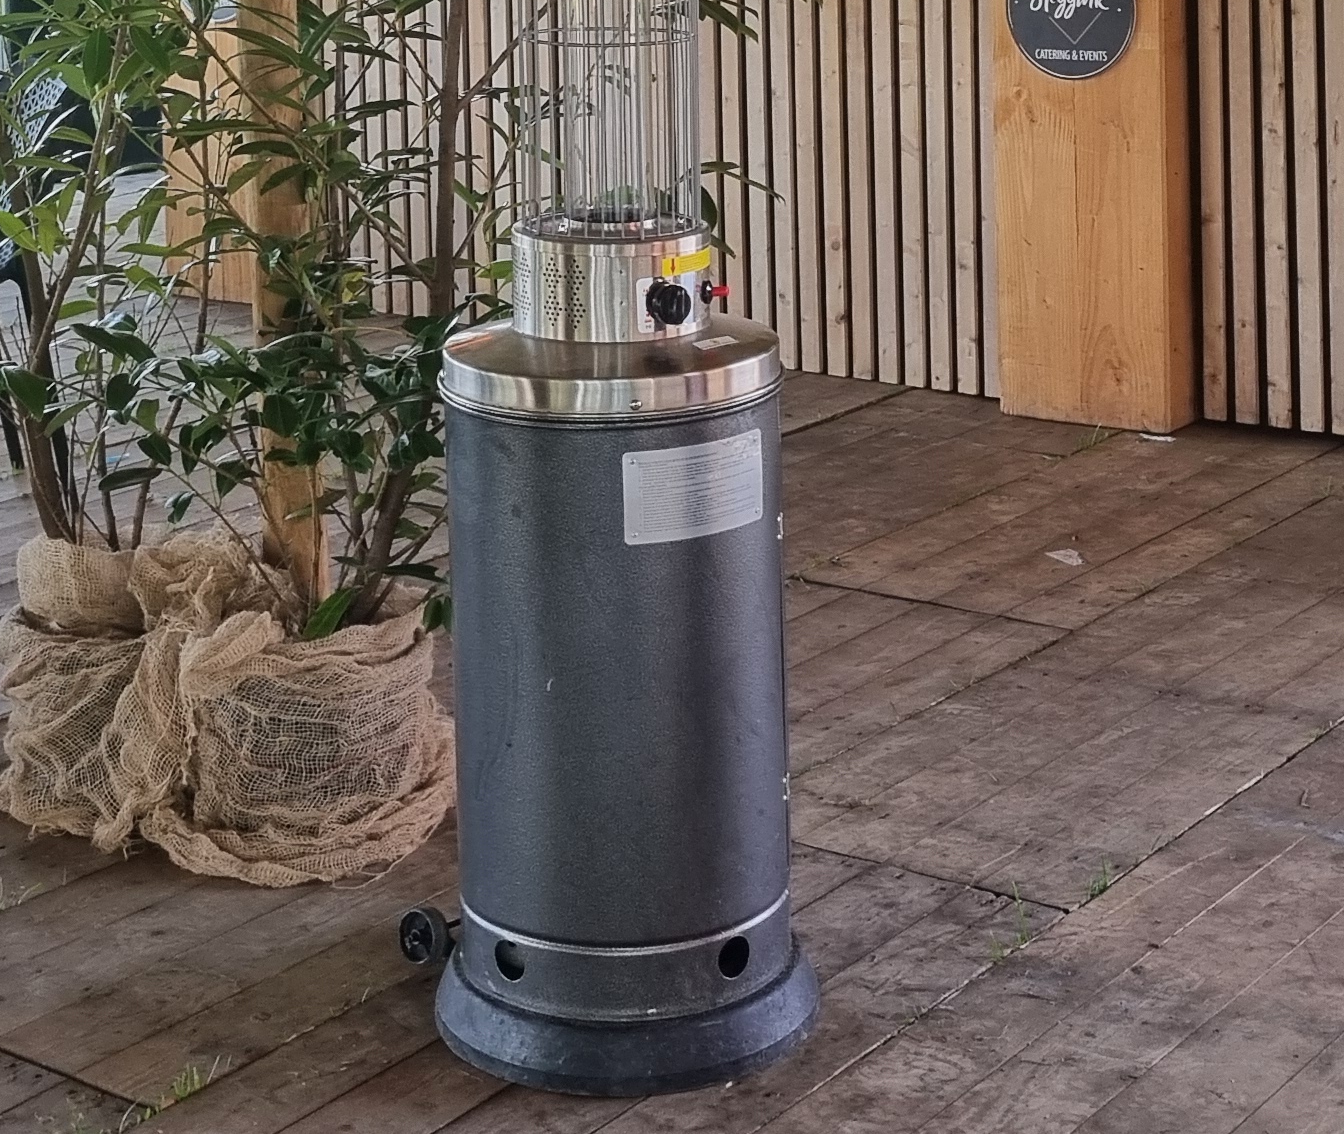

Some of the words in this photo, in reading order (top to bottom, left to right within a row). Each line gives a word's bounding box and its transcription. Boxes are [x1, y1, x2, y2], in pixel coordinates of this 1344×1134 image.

[1035, 48, 1071, 61] CATERING
[1072, 50, 1078, 61] &
[1079, 49, 1108, 62] EVENTS
